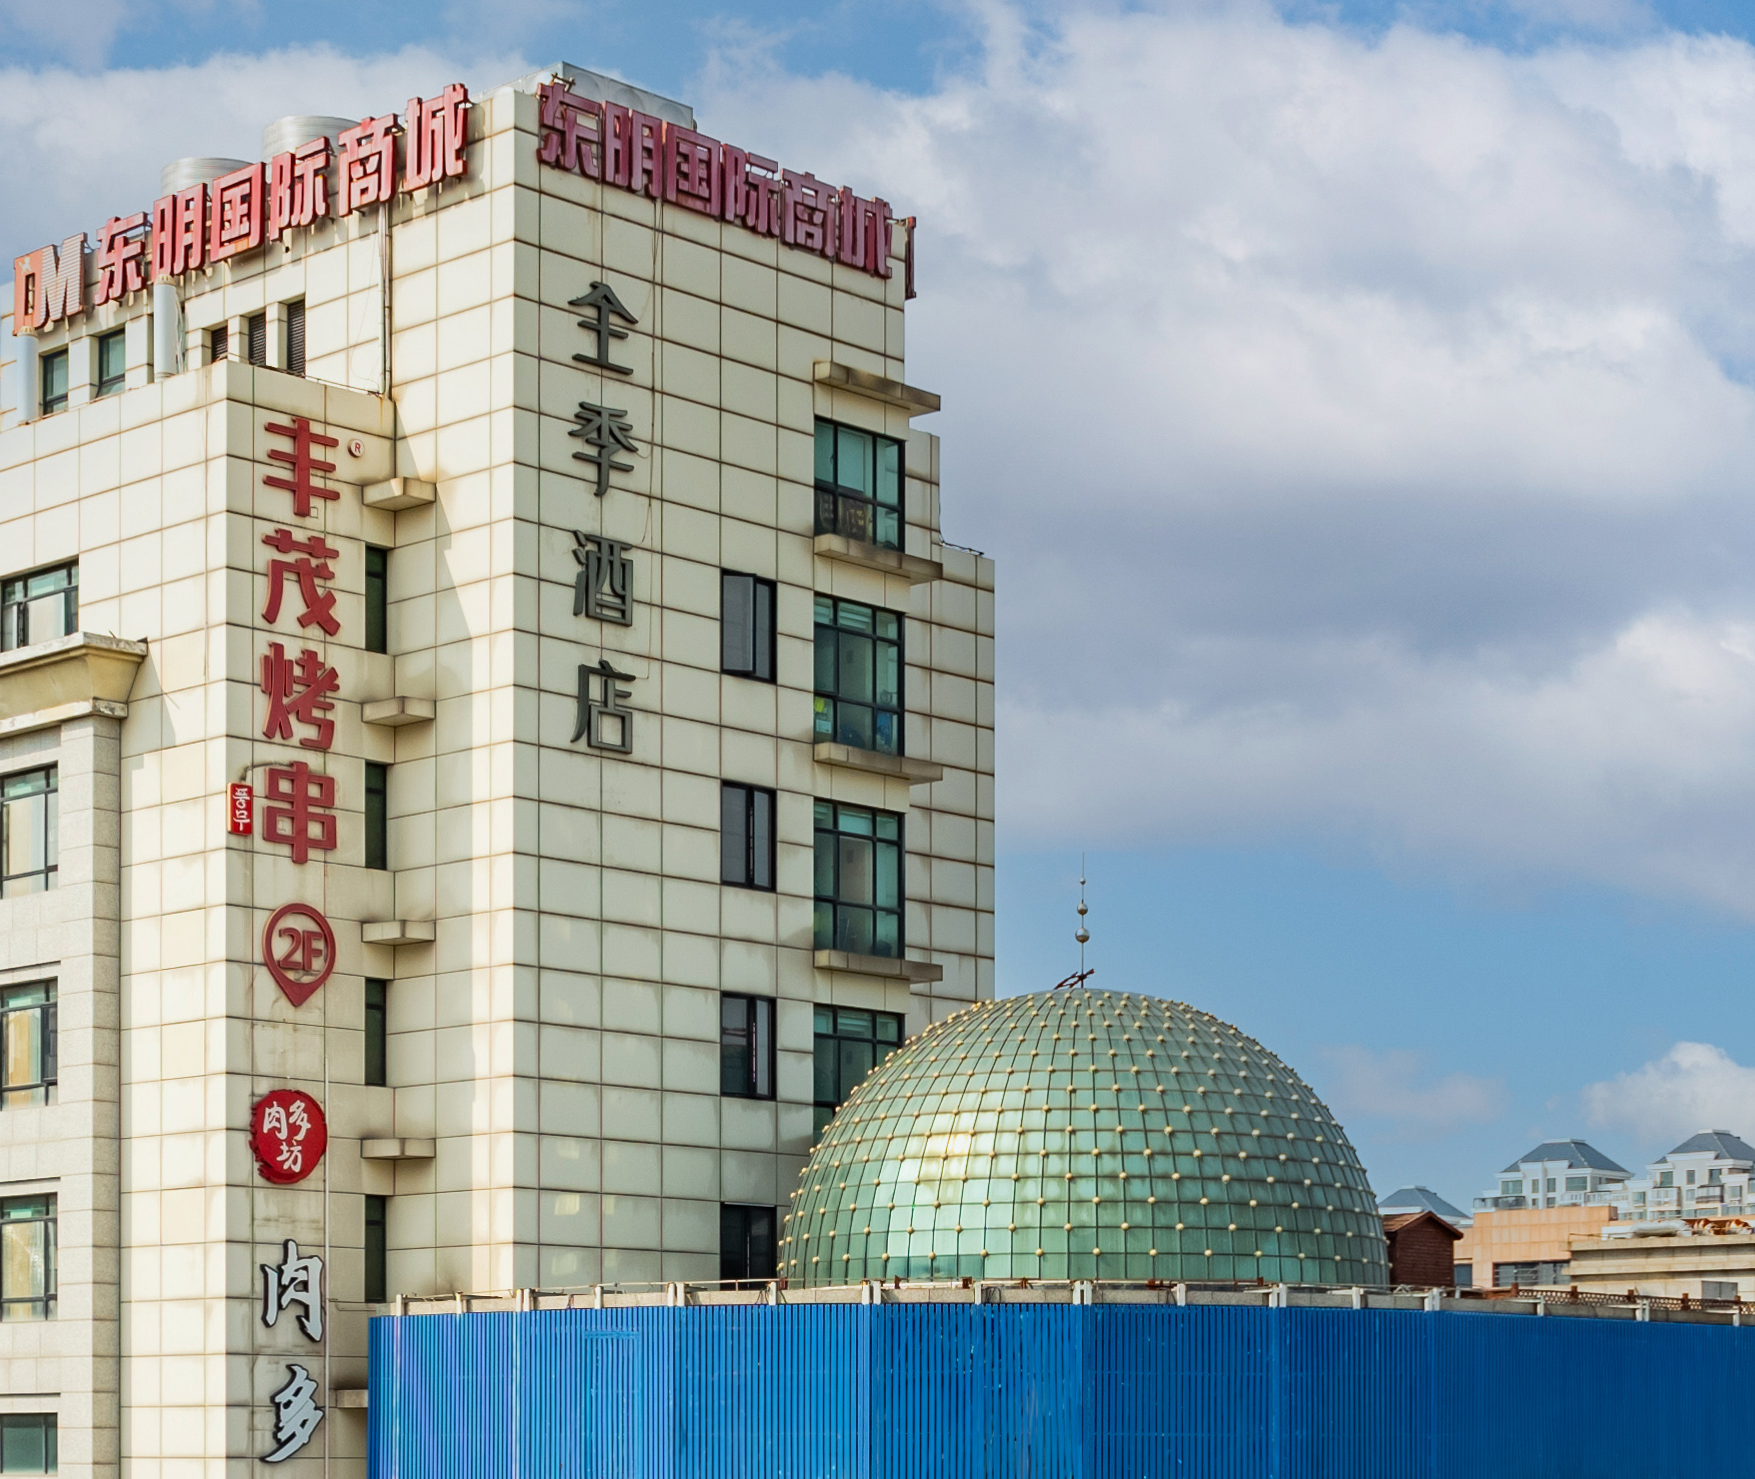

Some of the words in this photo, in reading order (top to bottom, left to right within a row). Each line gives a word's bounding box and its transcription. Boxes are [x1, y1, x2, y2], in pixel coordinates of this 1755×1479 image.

[95, 82, 470, 306] 东明国际商城
[535, 76, 895, 280] 东明国际商城
[563, 280, 641, 752] 全季酒店
[260, 416, 341, 865] 丰茂烤串
[278, 926, 324, 972] 2F
[263, 1100, 312, 1173] 肉多坊
